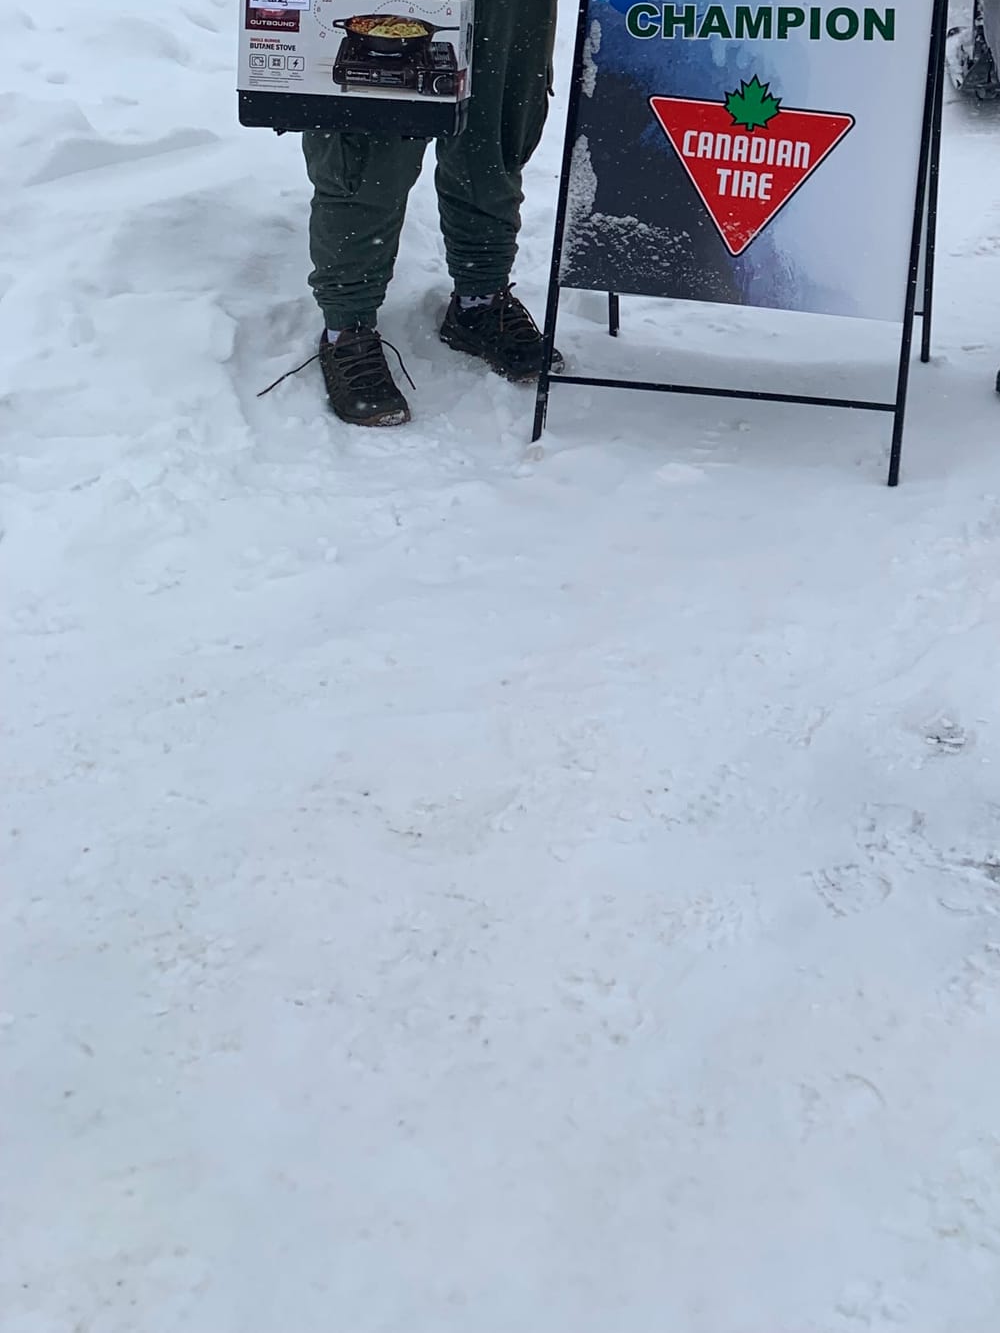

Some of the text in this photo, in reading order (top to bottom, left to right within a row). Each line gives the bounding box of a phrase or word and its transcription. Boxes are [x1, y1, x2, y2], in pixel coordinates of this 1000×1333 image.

[250, 19, 295, 27] OUTBOUND
[626, 3, 897, 42] CHAMPION
[250, 42, 296, 52] BUTANE STOVE
[682, 129, 811, 170] CANADIAN
[716, 168, 774, 201] TIRE
